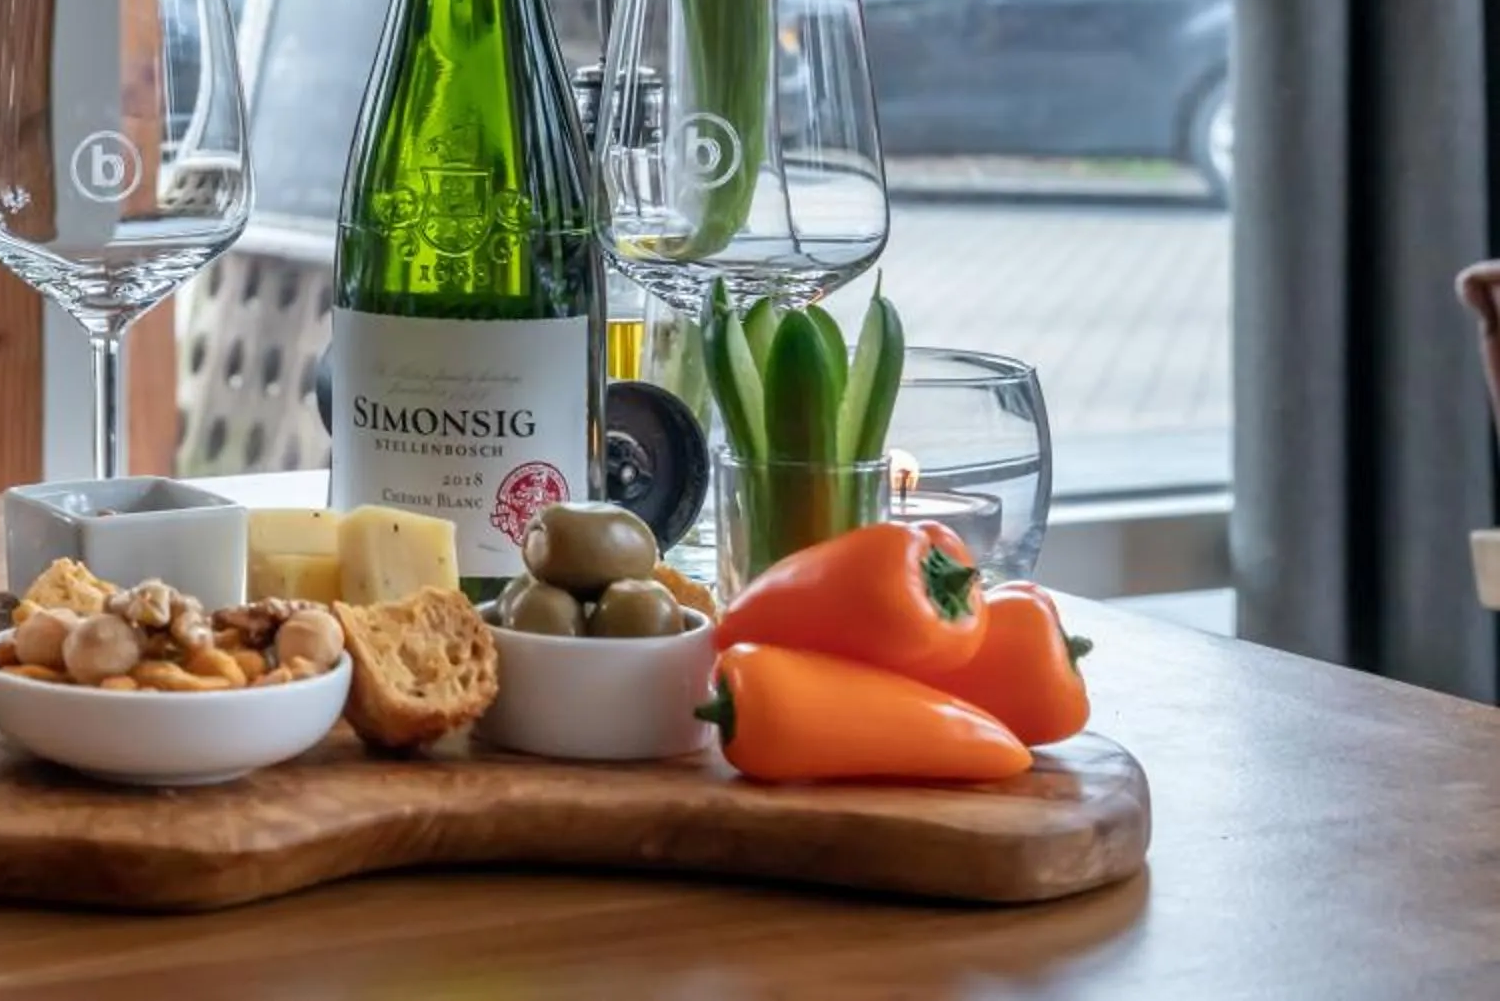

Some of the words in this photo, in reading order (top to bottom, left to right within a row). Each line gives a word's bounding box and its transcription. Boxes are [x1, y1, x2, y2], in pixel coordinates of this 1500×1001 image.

[353, 395, 536, 439] SIMONSIG
[375, 439, 503, 457] STELLENBOSCH
[442, 472, 484, 487] 2018
